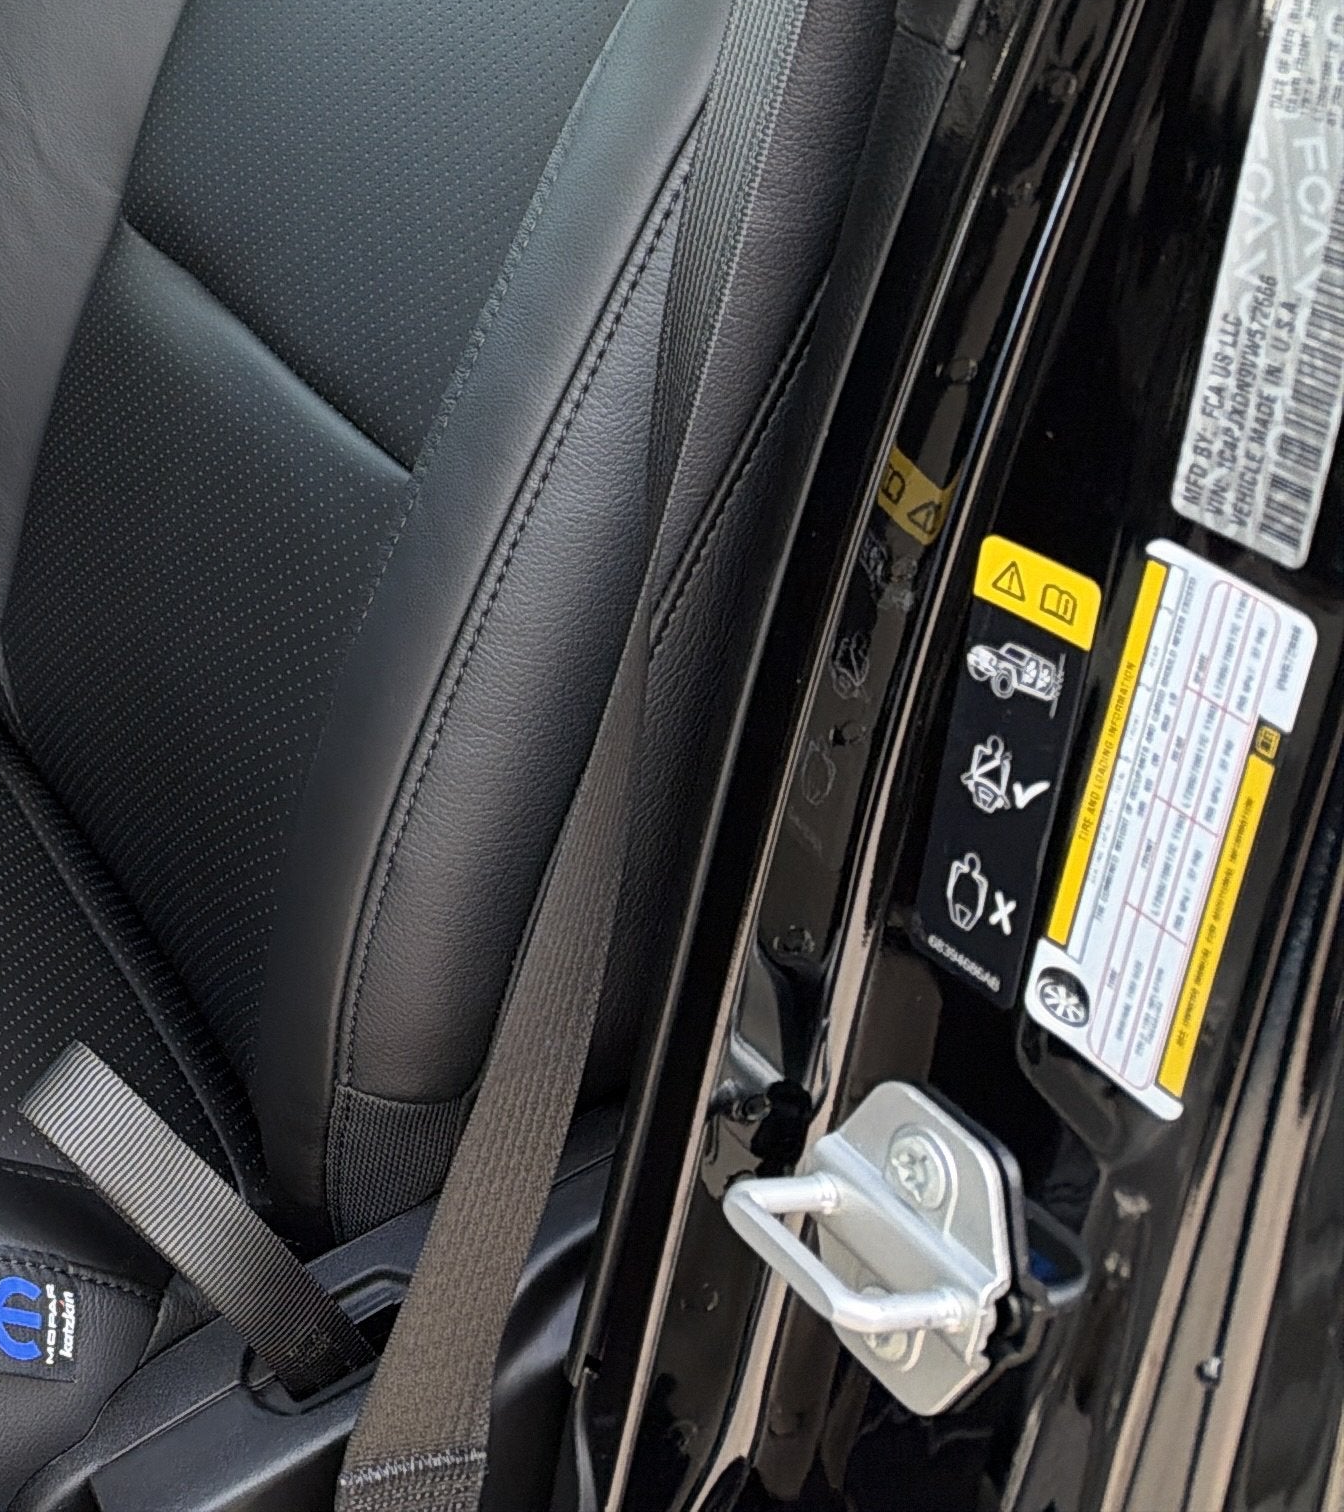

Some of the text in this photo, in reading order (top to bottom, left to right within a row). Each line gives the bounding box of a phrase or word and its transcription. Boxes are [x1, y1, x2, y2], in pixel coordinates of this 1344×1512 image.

[1216, 311, 1243, 348] LLC
[1209, 350, 1235, 379] US
[1261, 362, 1282, 385] IN
[1199, 382, 1227, 420] FCA
[1246, 388, 1278, 445] MADE
[1180, 462, 1208, 506] MFD
[1227, 449, 1265, 526] VEHICLE
[45, 1283, 58, 1365] MOPAR
